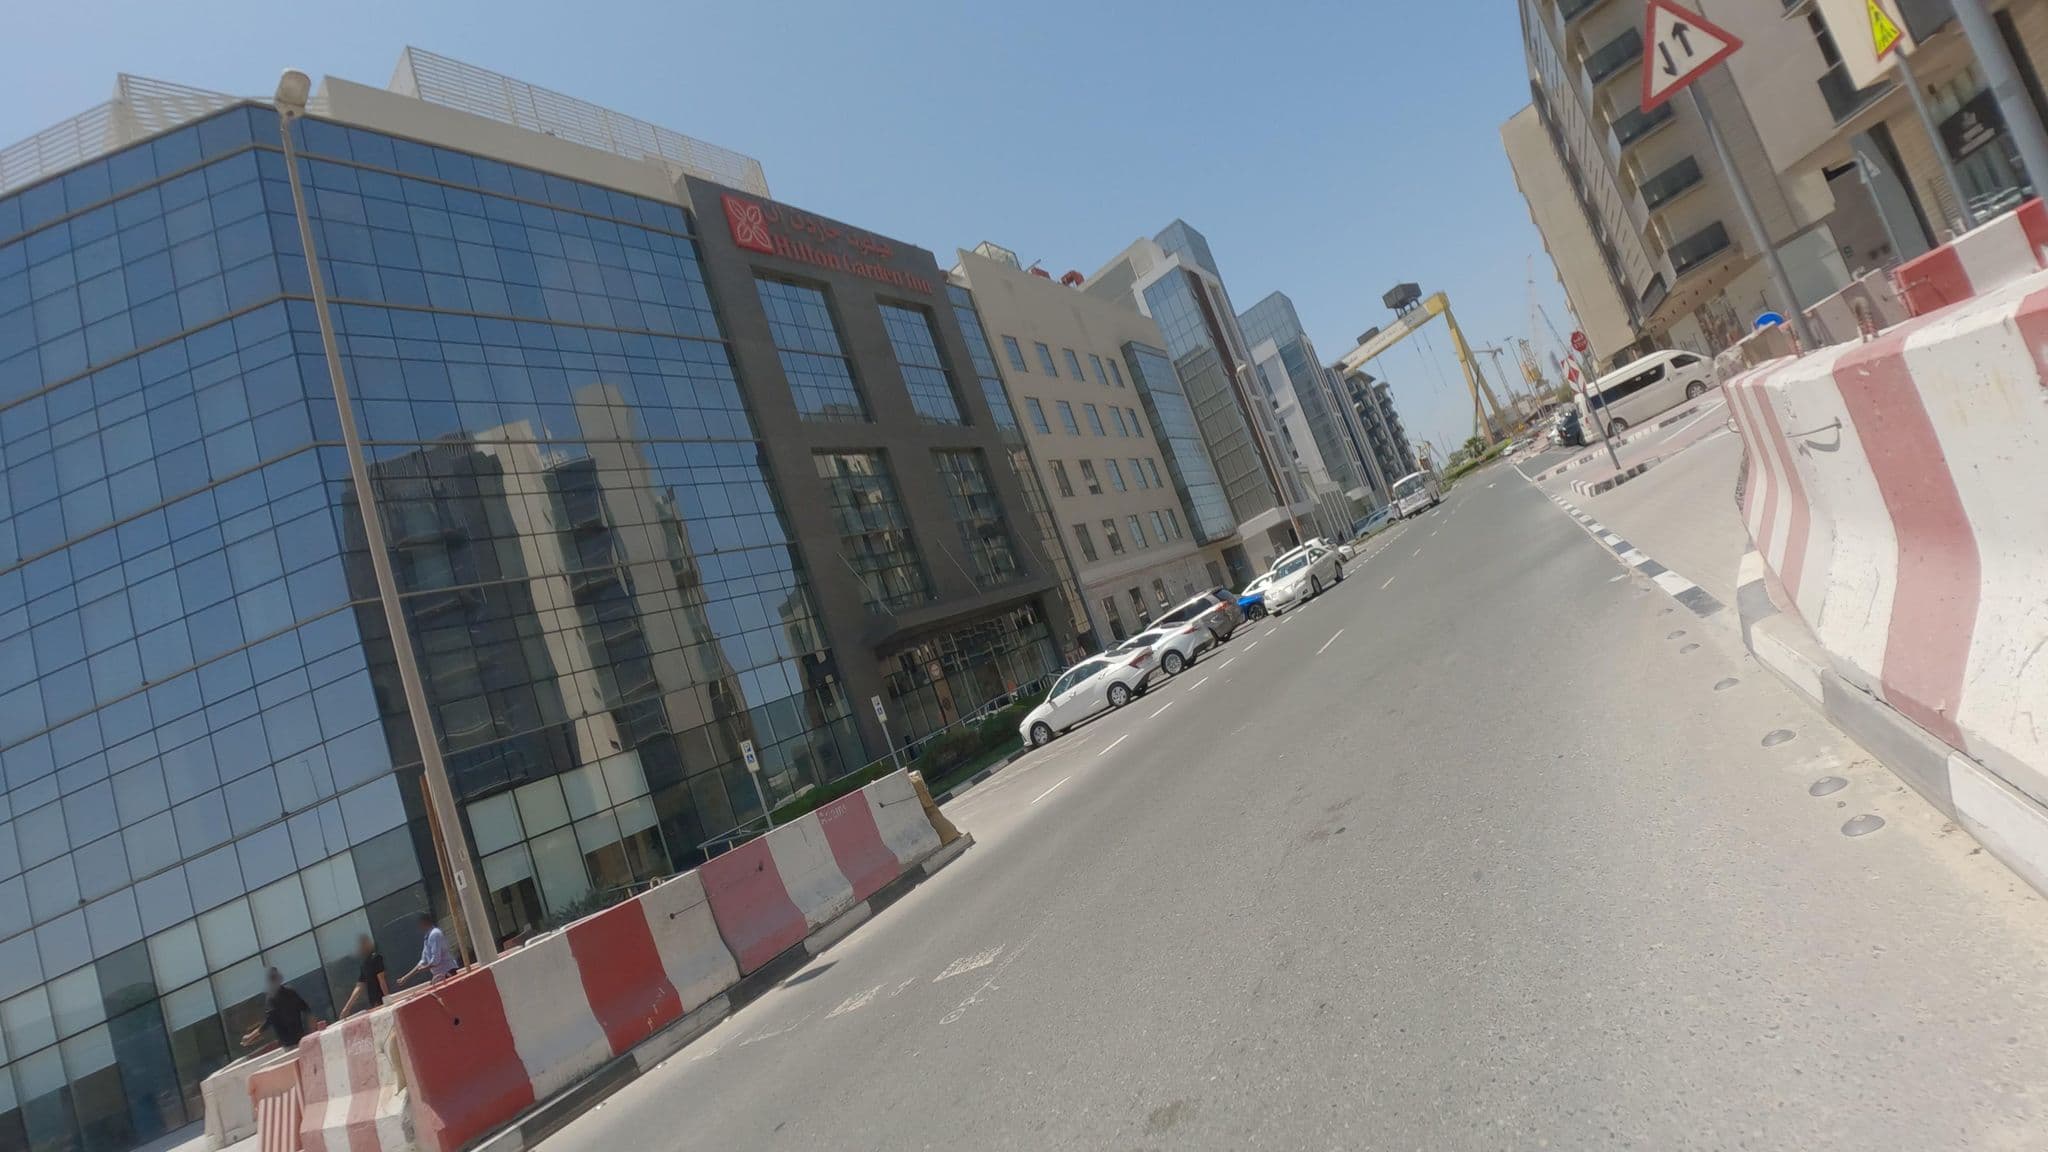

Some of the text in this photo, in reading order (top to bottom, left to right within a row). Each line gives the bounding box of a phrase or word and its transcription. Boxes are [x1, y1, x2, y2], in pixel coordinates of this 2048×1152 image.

[772, 235, 933, 296] Hilton Garden Inn
